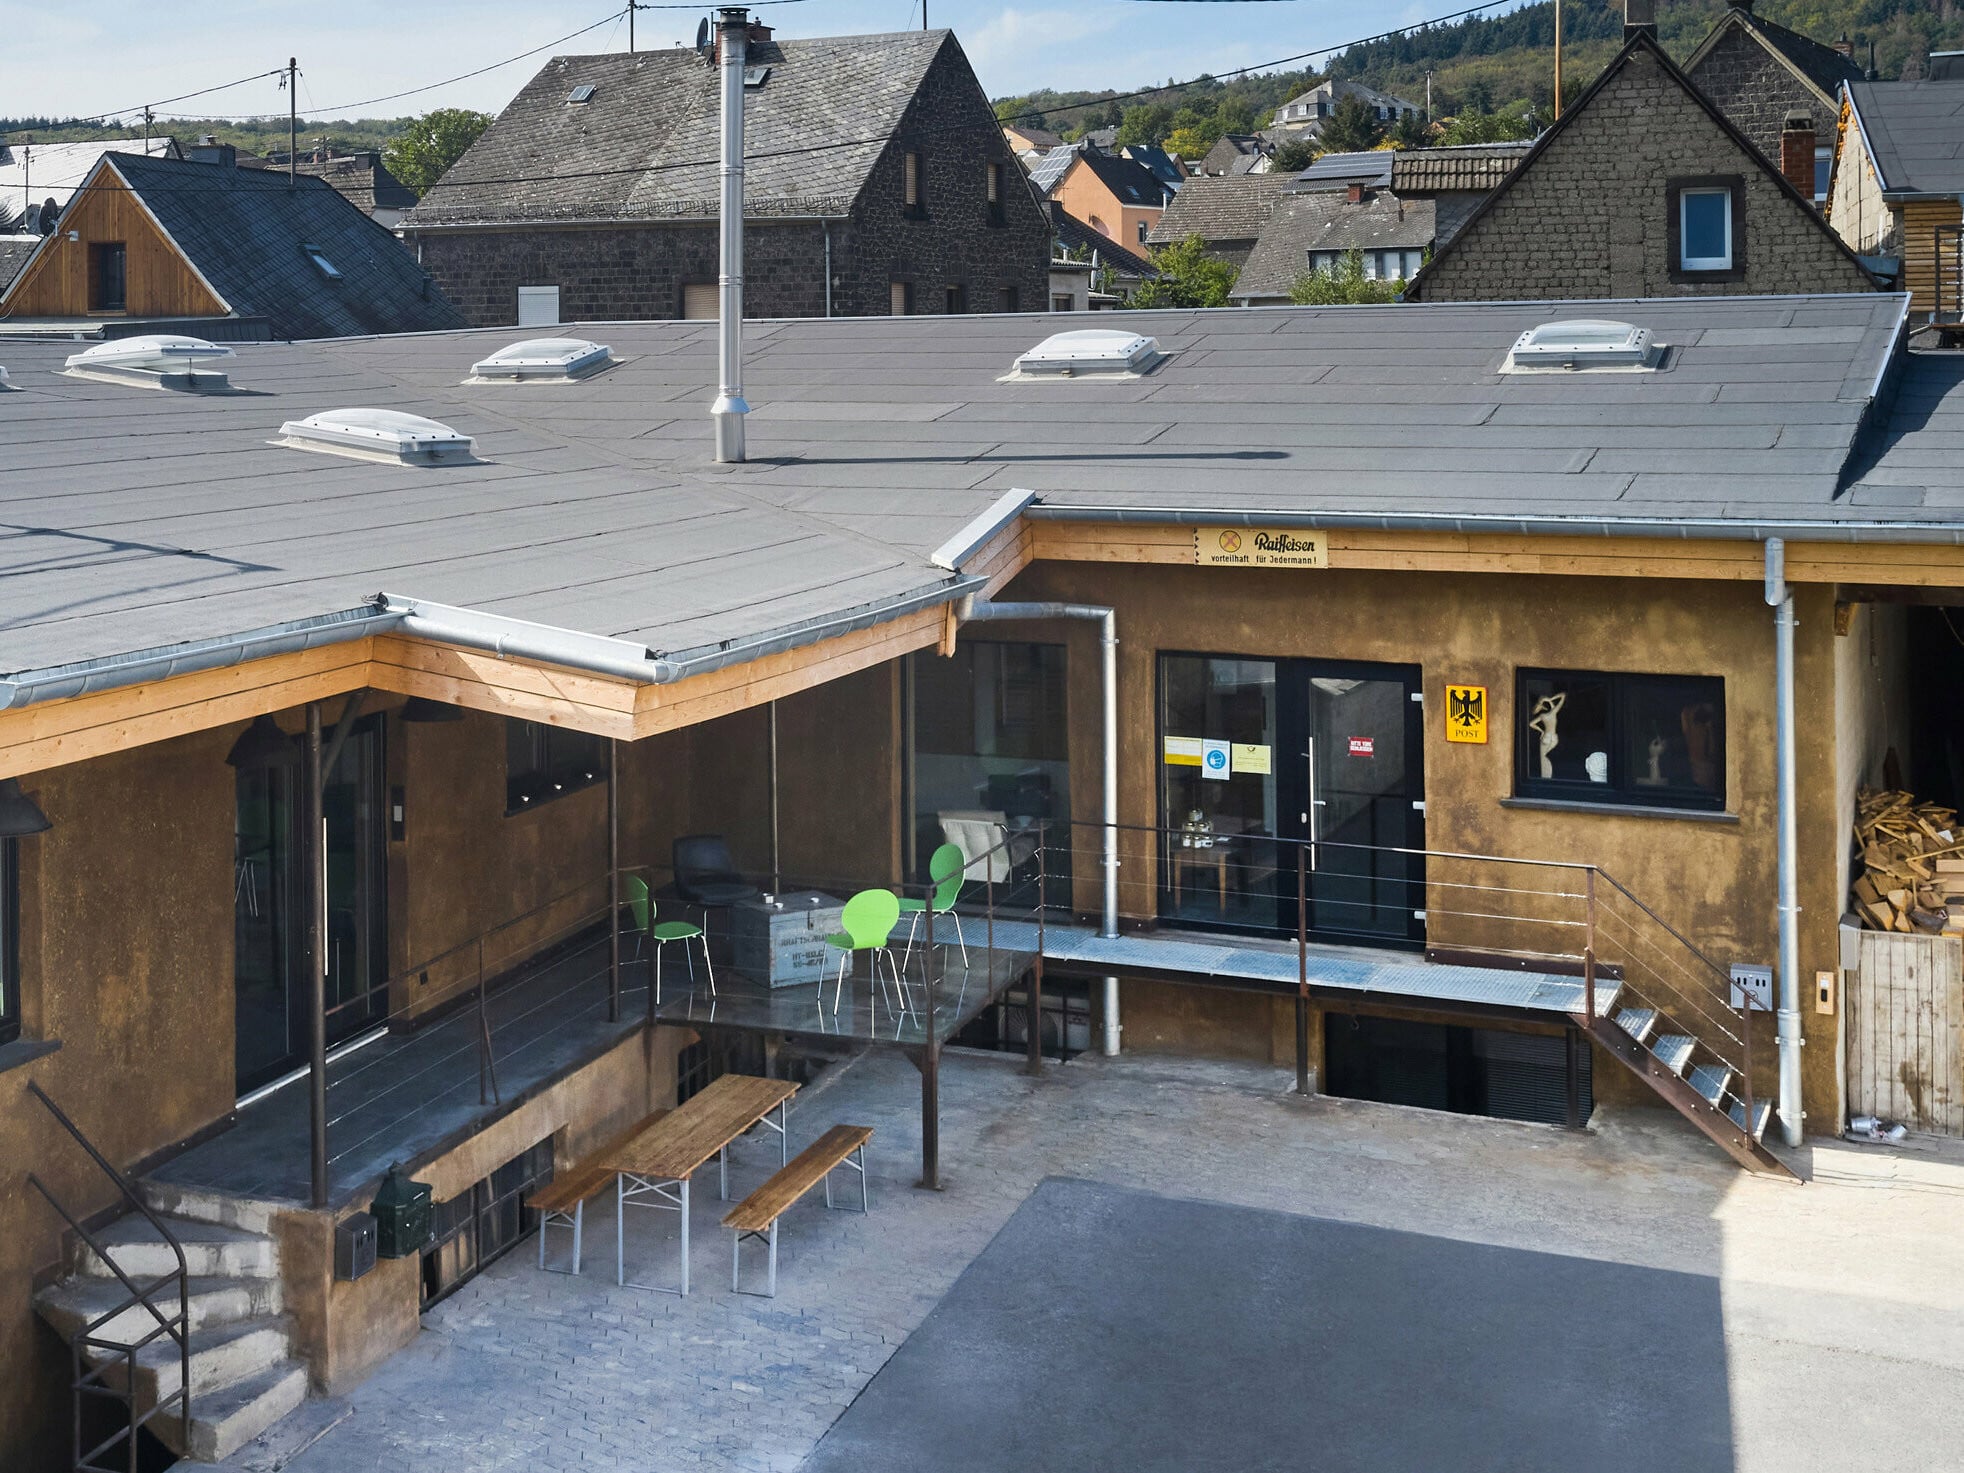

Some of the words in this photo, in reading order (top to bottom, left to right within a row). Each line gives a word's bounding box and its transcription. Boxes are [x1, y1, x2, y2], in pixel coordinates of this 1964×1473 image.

[1254, 532, 1315, 553] Raiffeisen
[1211, 554, 1249, 563] vorteilhaft
[1256, 555, 1266, 563] für
[1455, 729, 1479, 738] POST
